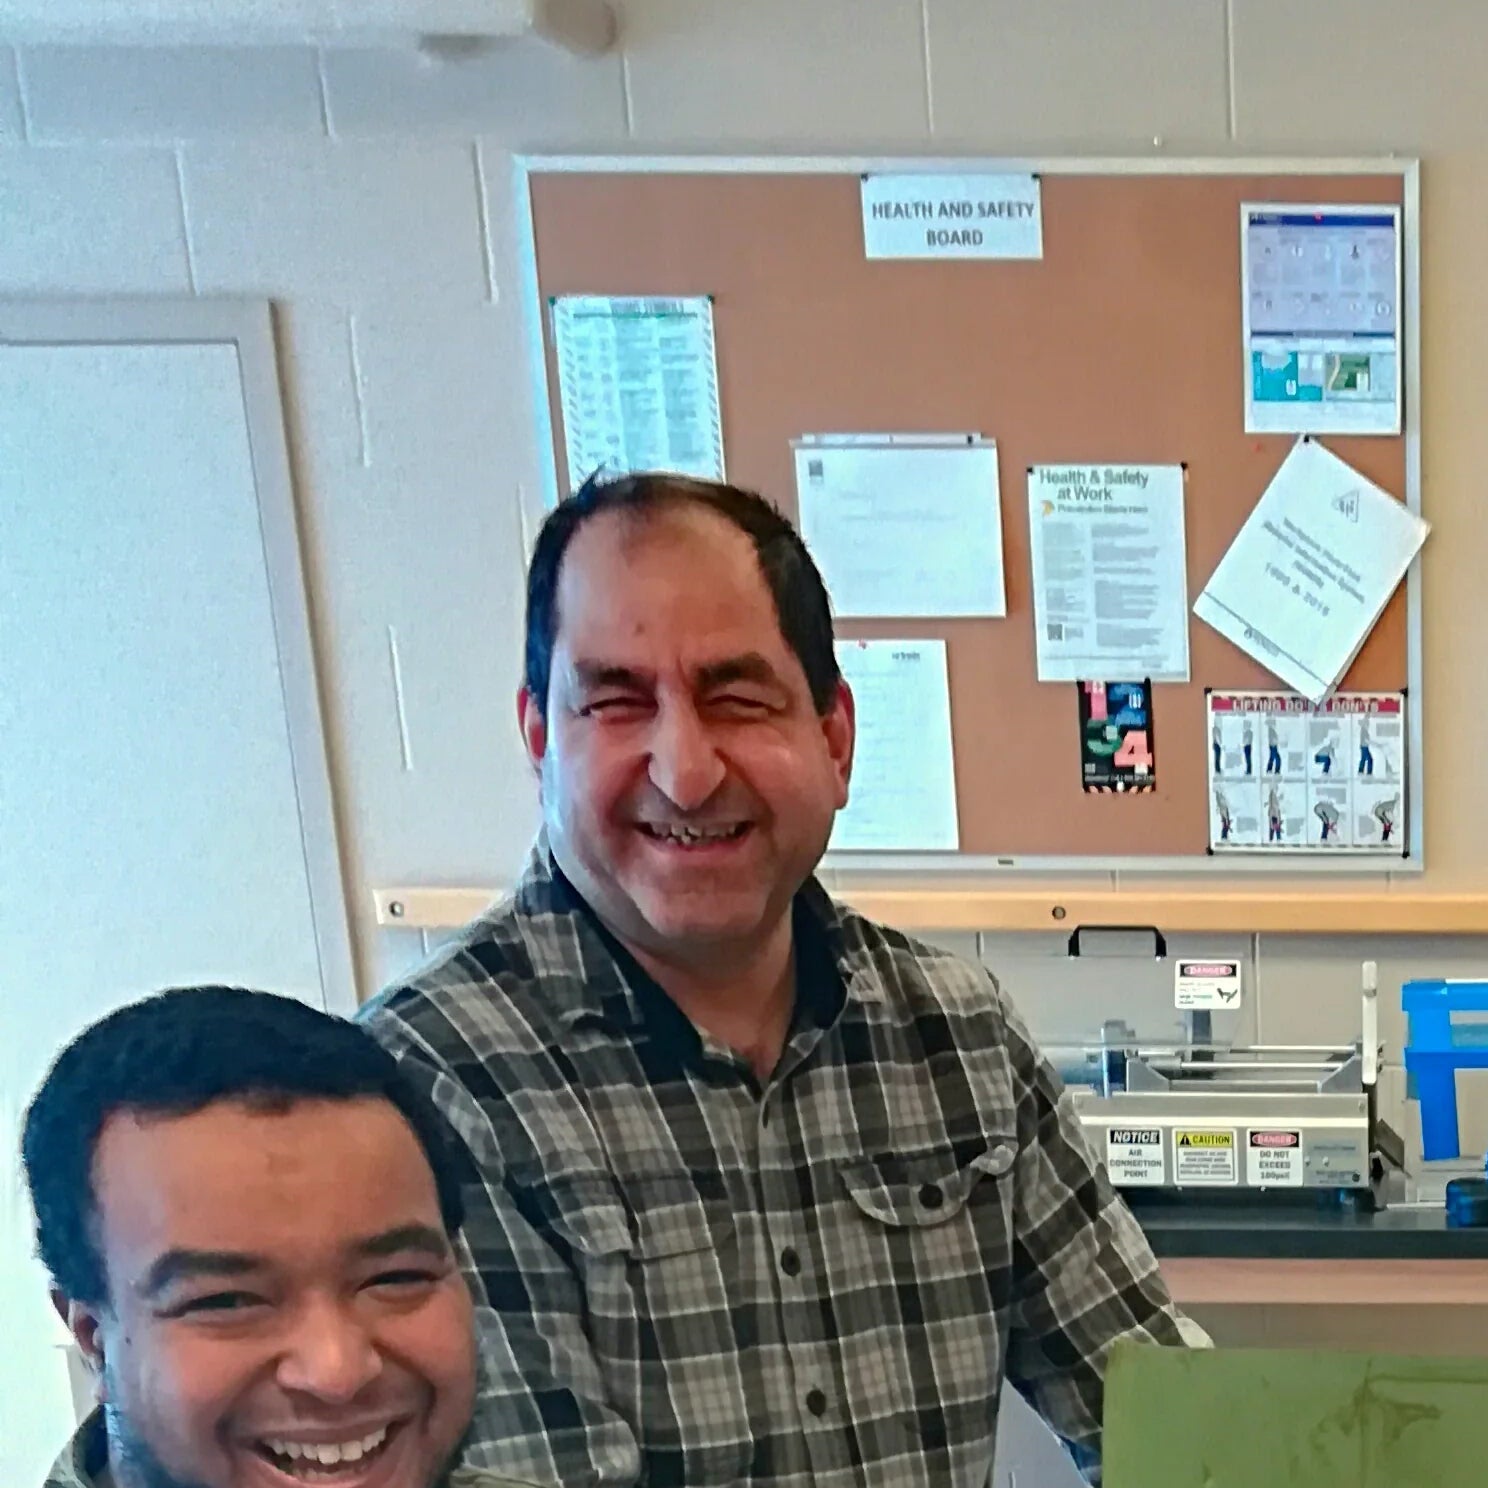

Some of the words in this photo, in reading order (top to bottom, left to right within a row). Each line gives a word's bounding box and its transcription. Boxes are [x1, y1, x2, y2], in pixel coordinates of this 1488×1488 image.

[872, 202, 932, 218] HEALTH
[939, 201, 973, 217] AND
[978, 202, 1033, 217] SAFETY
[927, 229, 983, 246] BOARD
[1040, 470, 1086, 485] Health
[1090, 470, 1100, 484] &
[1104, 469, 1148, 488] Safety
[1058, 488, 1071, 500] at
[1074, 487, 1112, 500] Work
[1114, 1131, 1157, 1143] NOTICE
[1193, 1135, 1230, 1145] CAUTION
[1129, 1149, 1142, 1157] AIR
[1274, 1151, 1289, 1159] NOT
[1124, 1170, 1148, 1178] POINT
